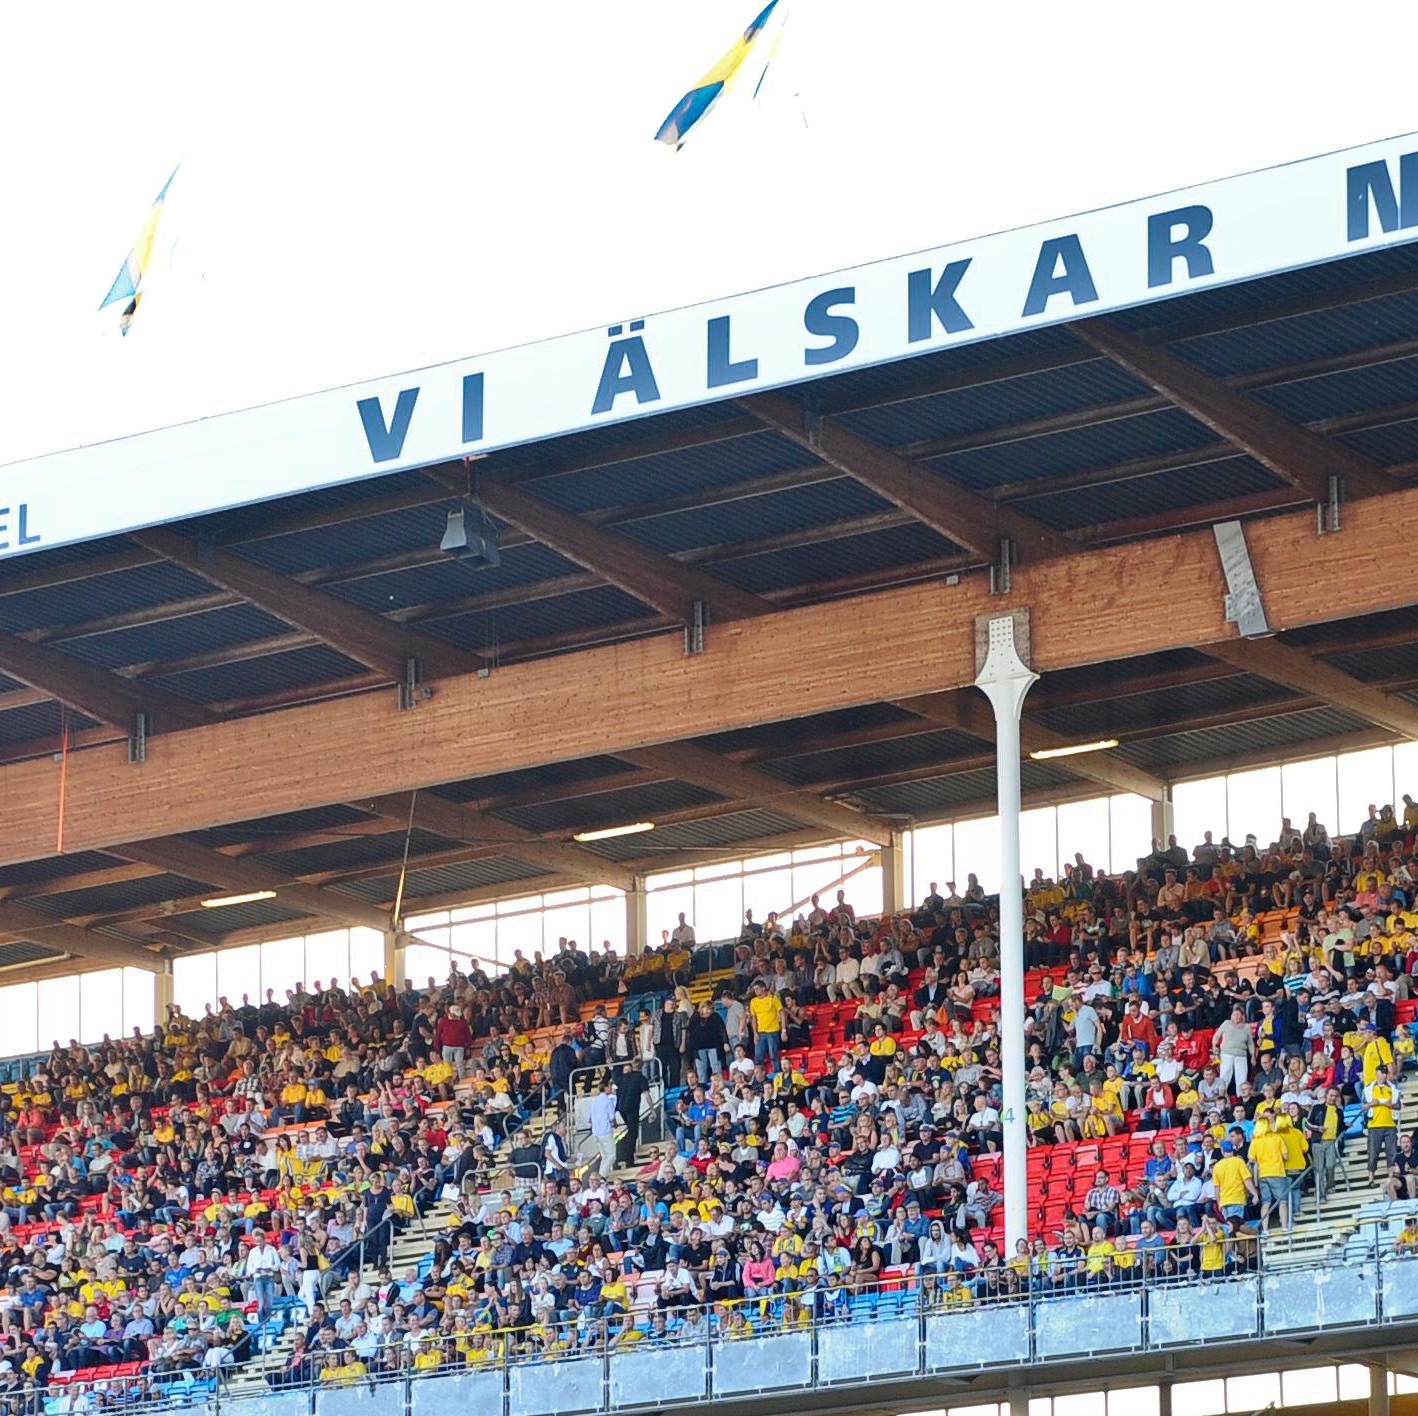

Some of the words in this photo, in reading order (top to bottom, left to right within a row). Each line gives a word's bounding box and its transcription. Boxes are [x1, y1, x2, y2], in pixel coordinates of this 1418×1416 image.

[355, 371, 485, 464] VI
[589, 204, 1215, 416] ÄLSKAR
[1004, 1107, 1016, 1124] 4
